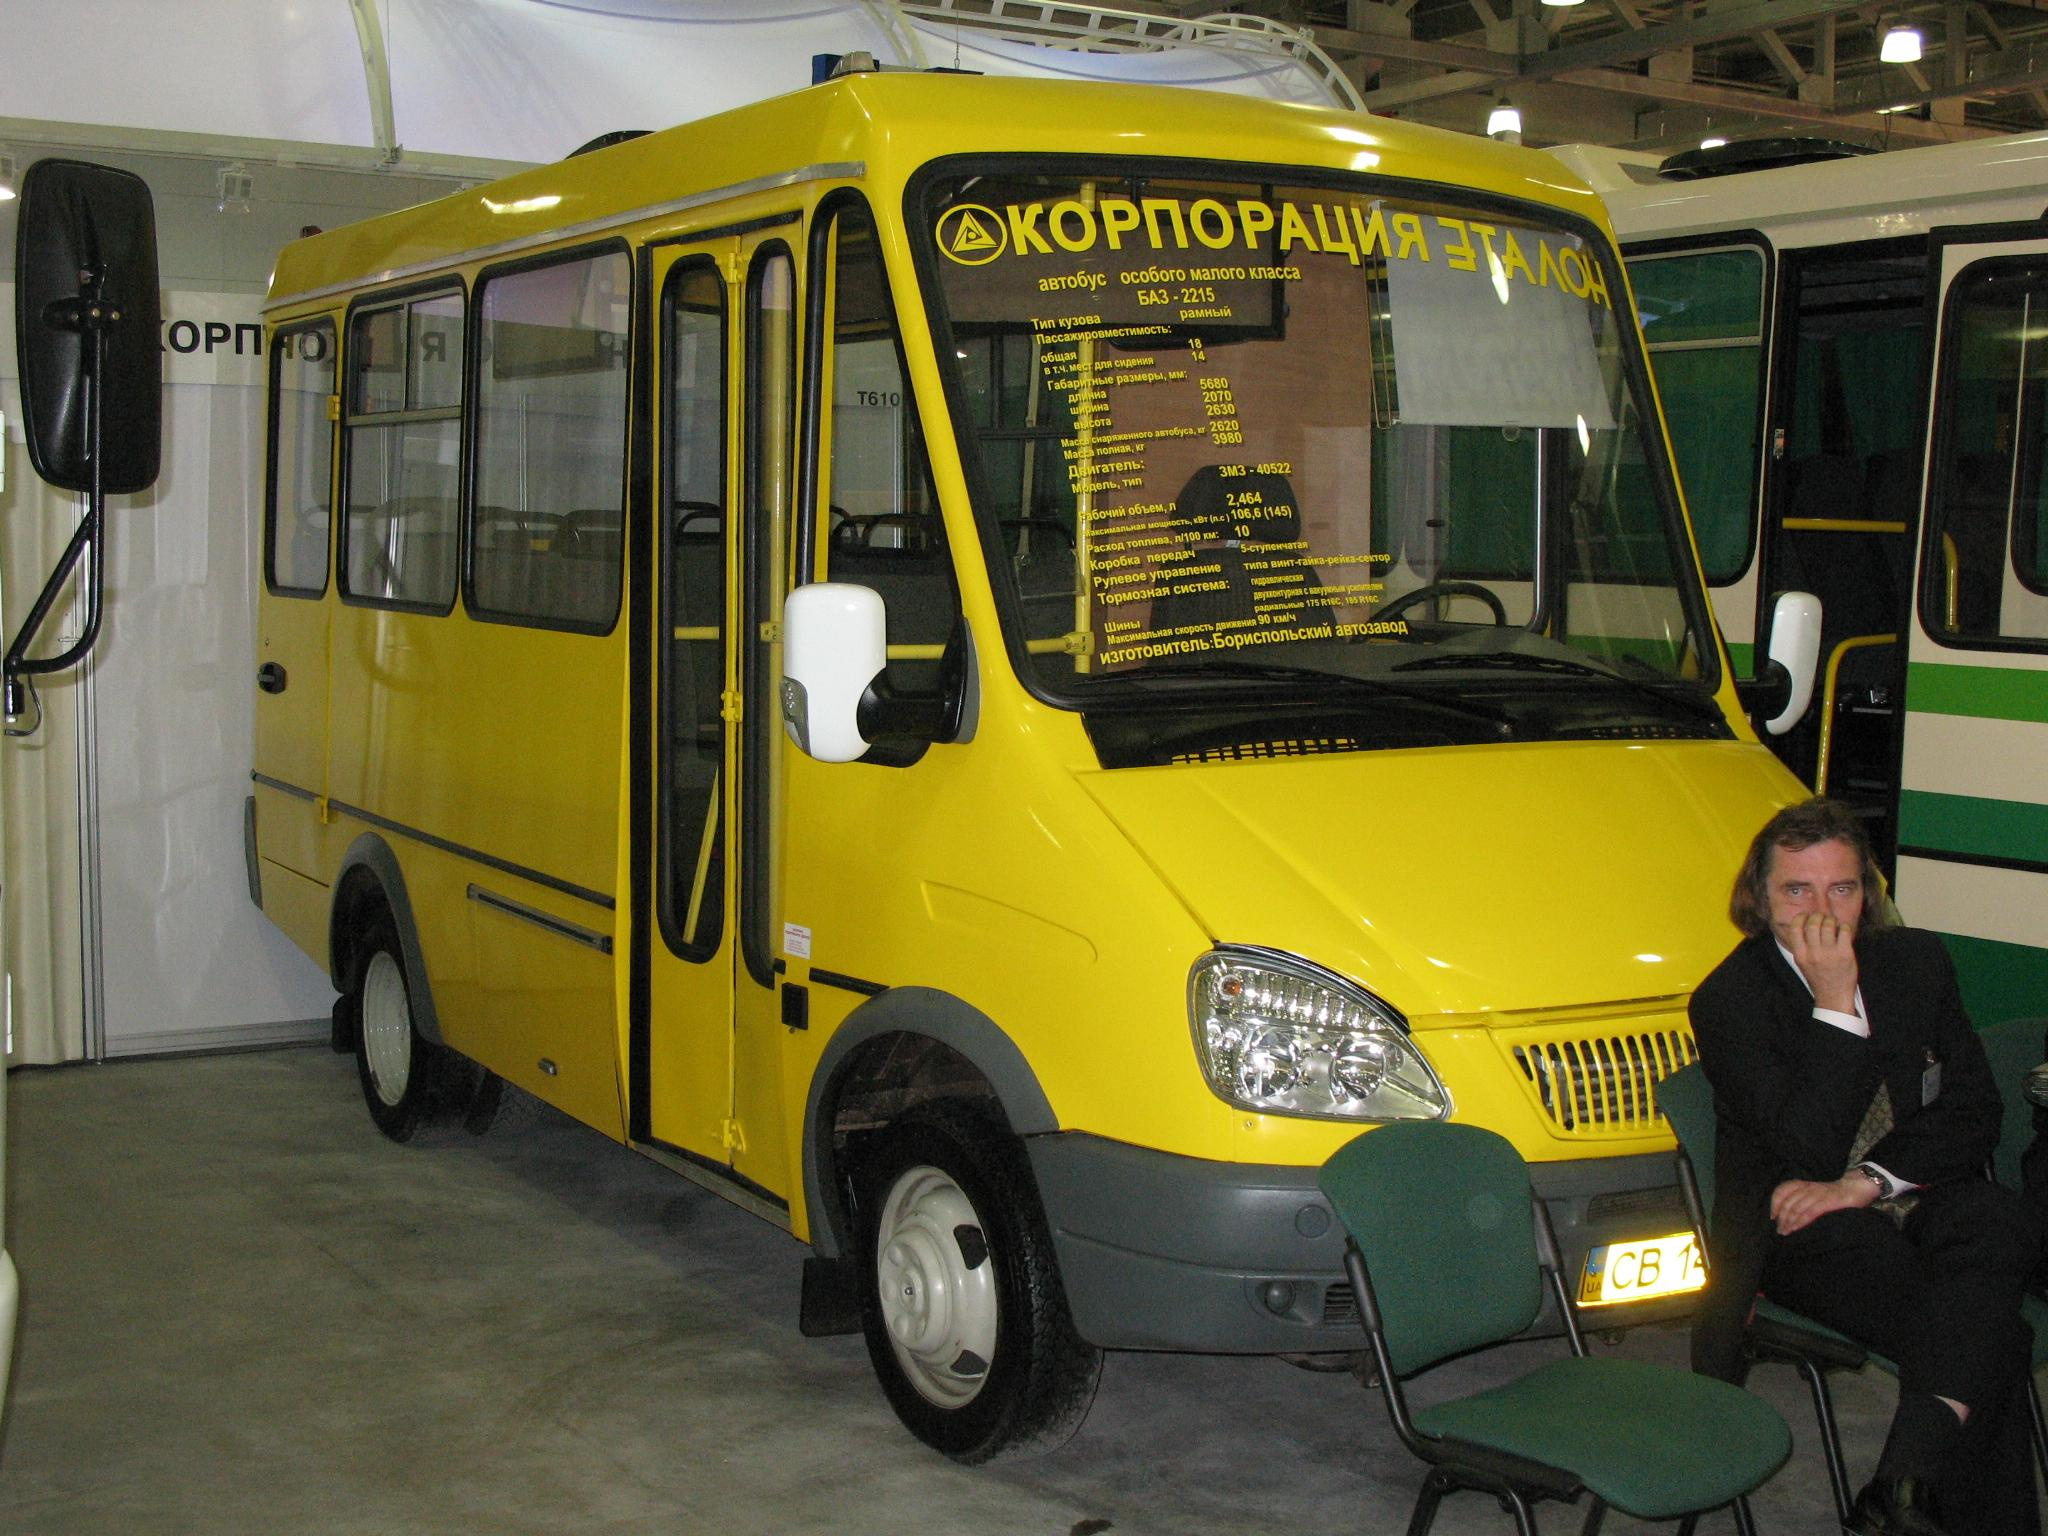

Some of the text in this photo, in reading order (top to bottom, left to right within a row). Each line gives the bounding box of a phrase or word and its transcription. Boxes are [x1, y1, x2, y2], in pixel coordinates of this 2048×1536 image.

[1007, 199, 1430, 266] КОРПОРАЦИЯ
[1038, 265, 1301, 292] автобус особого малого класса
[1137, 289, 1169, 306] БАЗ
[1181, 287, 1216, 305] 2215
[1031, 306, 1232, 331] Тип кузова рамный
[160, 319, 263, 356] ОРП
[1036, 325, 1172, 345] Пассажировместимость:
[1187, 338, 1203, 350] 18
[1040, 351, 1206, 364] общая 14
[1054, 365, 1069, 375] т.ч.
[1070, 362, 1093, 373] мест
[1094, 361, 1113, 371] для
[1114, 356, 1154, 368] сидения
[1047, 369, 1188, 391] Габаритные размеры, мм:
[1068, 377, 1229, 403] длинна 5680
[857, 391, 900, 406] T610
[1069, 390, 1232, 416] ширина 2070
[1073, 404, 1236, 431] высота 2630
[1060, 420, 1240, 448] Масса снаряженного автобуса, кг 2620
[1063, 432, 1243, 460] Масса полная, кг 3980
[1068, 460, 1145, 480] Двигатель:
[1071, 479, 1119, 494] Модель,
[1121, 477, 1143, 488] тип
[1218, 465, 1247, 478] ЗМЗ
[1256, 462, 1292, 475] 40522
[1128, 502, 1166, 517] объем,
[1168, 501, 1177, 512] л
[1225, 491, 1262, 507] 2,464
[1147, 518, 1193, 532] мощность,
[1193, 515, 1209, 525] кВт
[1230, 508, 1261, 521] 106,6
[1263, 505, 1292, 520] (145)
[1086, 525, 1250, 555] Расход топлива, л/100 км: 10
[1090, 540, 1309, 571] Коробка передач 5-ступенчатая
[1093, 553, 1391, 590] Рулевое управление типа винт-гайка-рейка-сектор
[1097, 585, 1171, 606] Тормозная
[1173, 579, 1231, 595] система:
[1103, 619, 1141, 633] Шины
[1254, 601, 1305, 613] радиальные
[1306, 599, 1320, 608] 175
[1106, 612, 1297, 646] Максимальная скорость движения 90 км/ч
[1335, 619, 1409, 638] автозавод
[1612, 1247, 1661, 1290] CB
